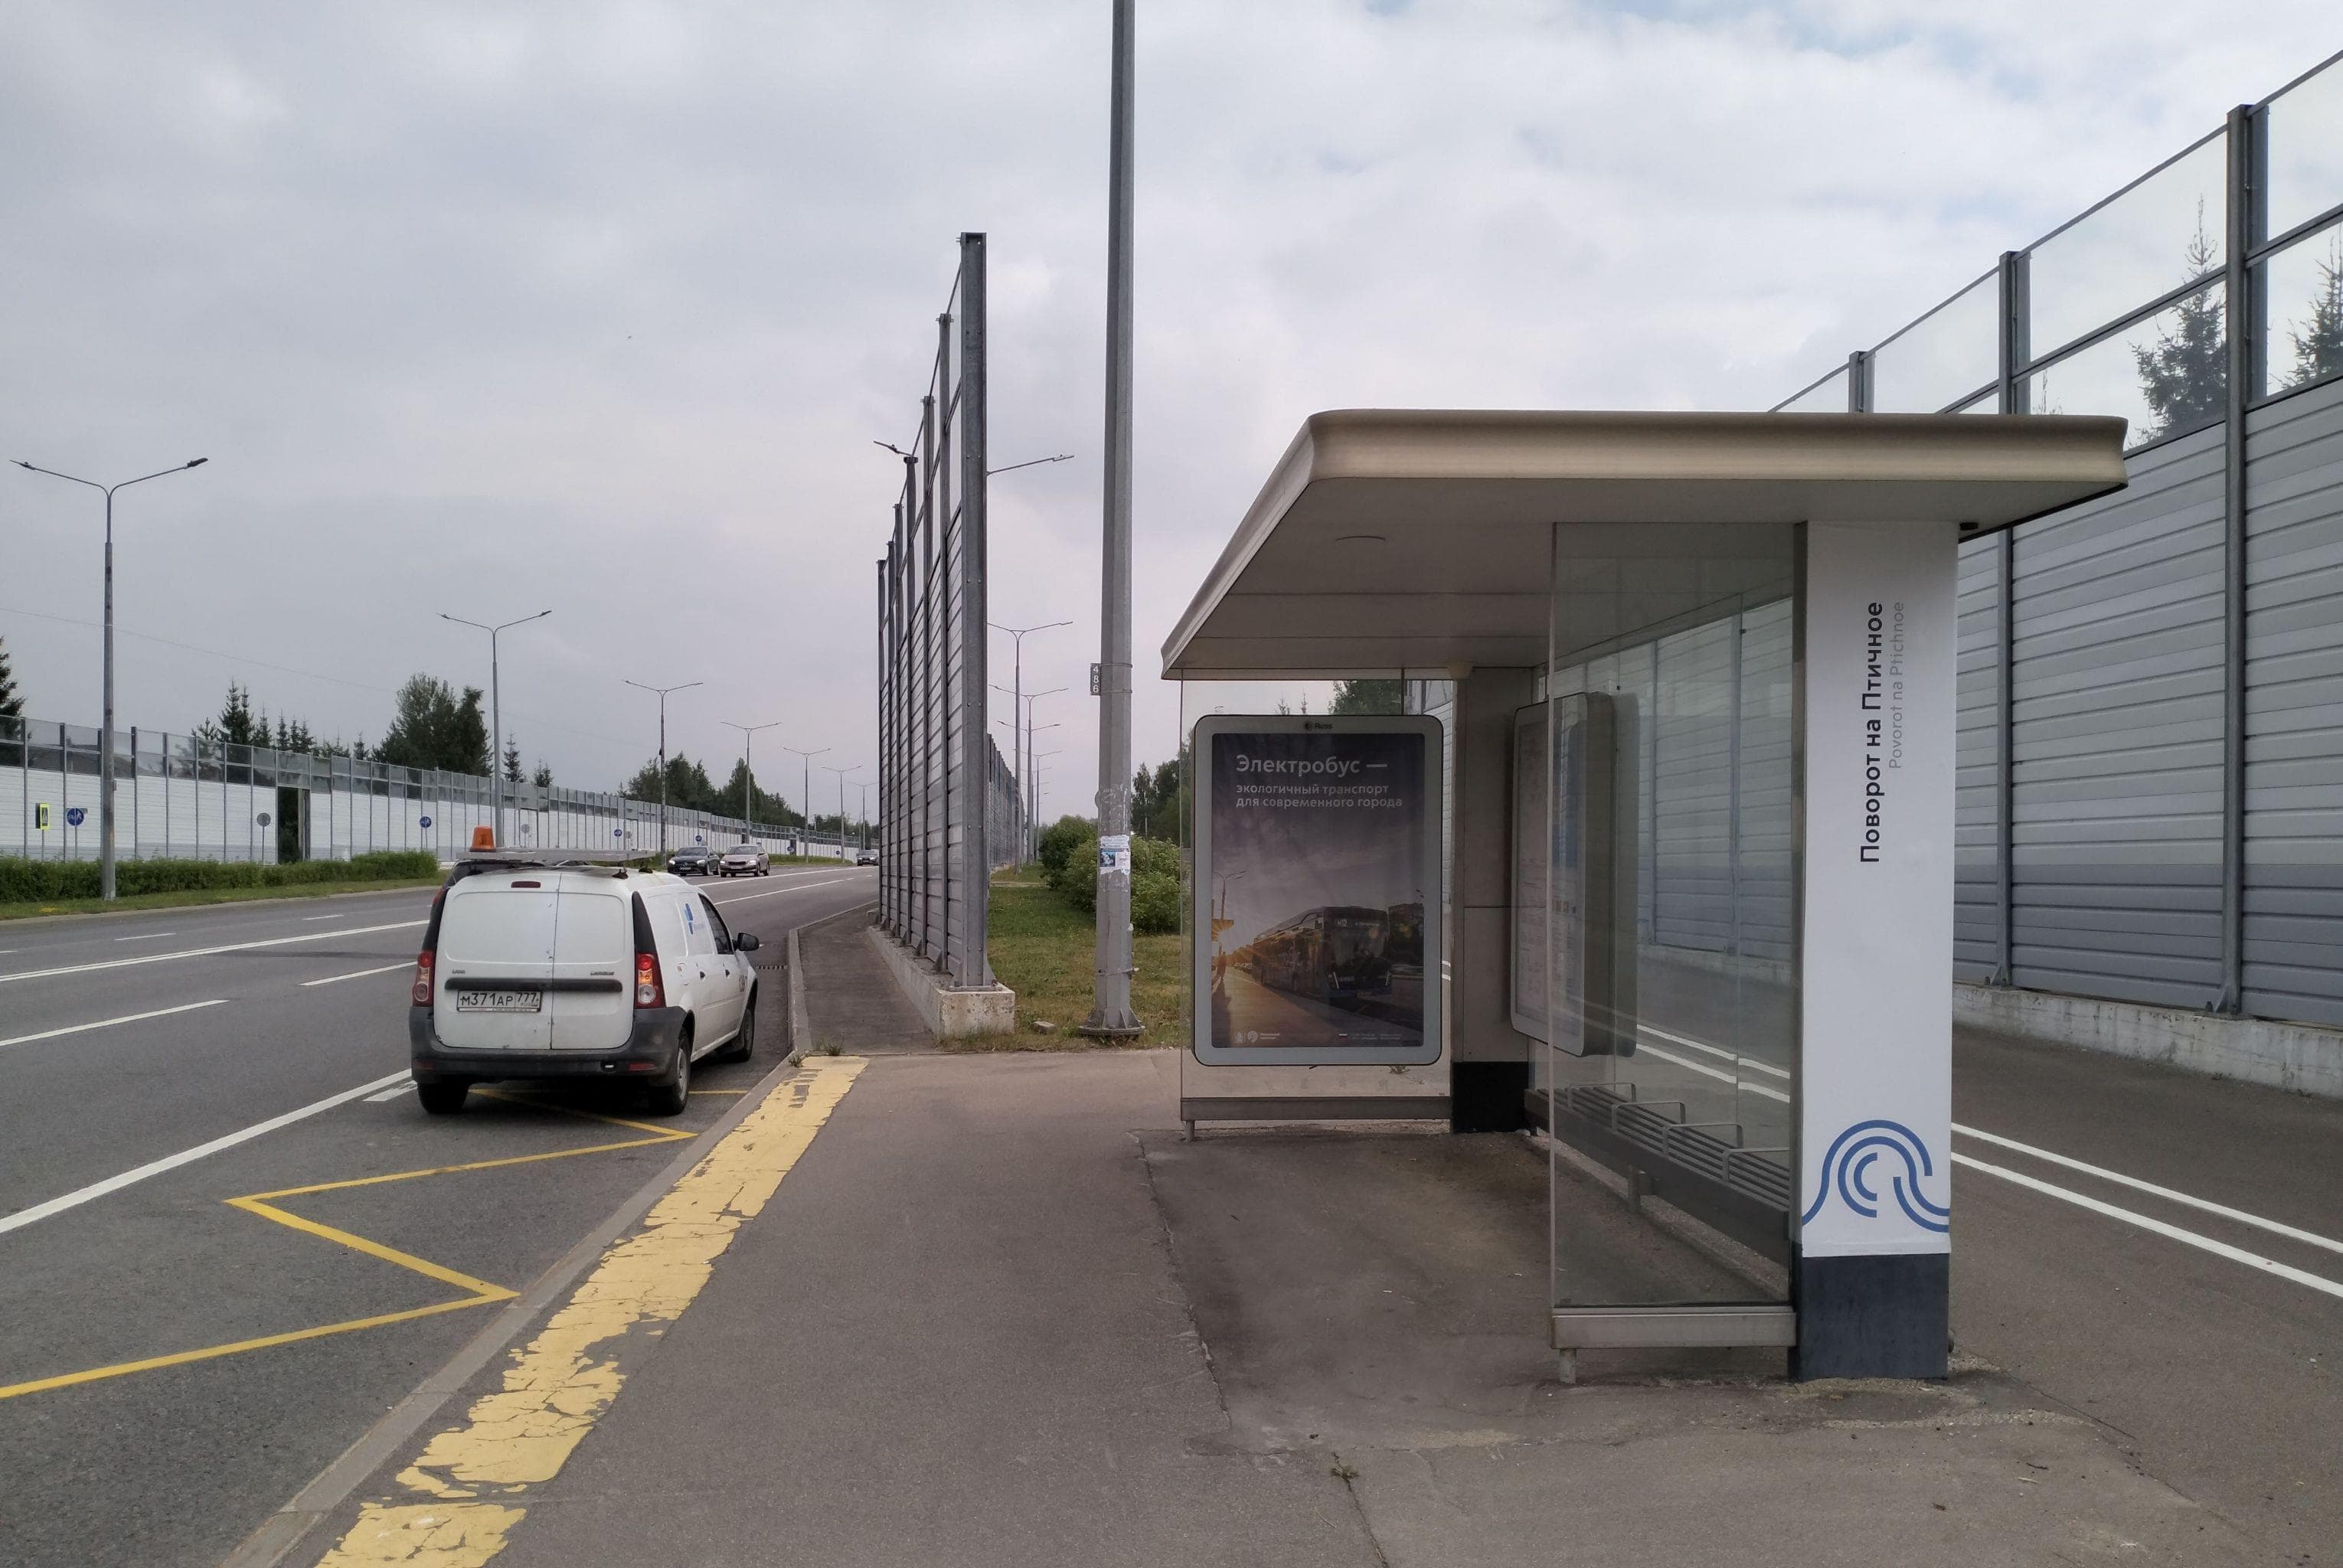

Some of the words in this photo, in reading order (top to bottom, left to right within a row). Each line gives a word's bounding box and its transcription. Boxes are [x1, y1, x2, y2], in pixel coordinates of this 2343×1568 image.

[1890, 602, 1904, 676] Ptichnoe
[1861, 602, 1883, 710] Птичное
[1892, 681, 1903, 700] na
[1866, 719, 1881, 747] на
[1889, 706, 1903, 769] Povorot
[1236, 754, 1360, 778] Электробус
[1236, 783, 1319, 795] экологичный
[1323, 785, 1389, 796] транспорт
[1236, 798, 1260, 808] для
[1263, 798, 1354, 808] современного
[1358, 798, 1403, 808] города
[1860, 753, 1885, 863] Поворот
